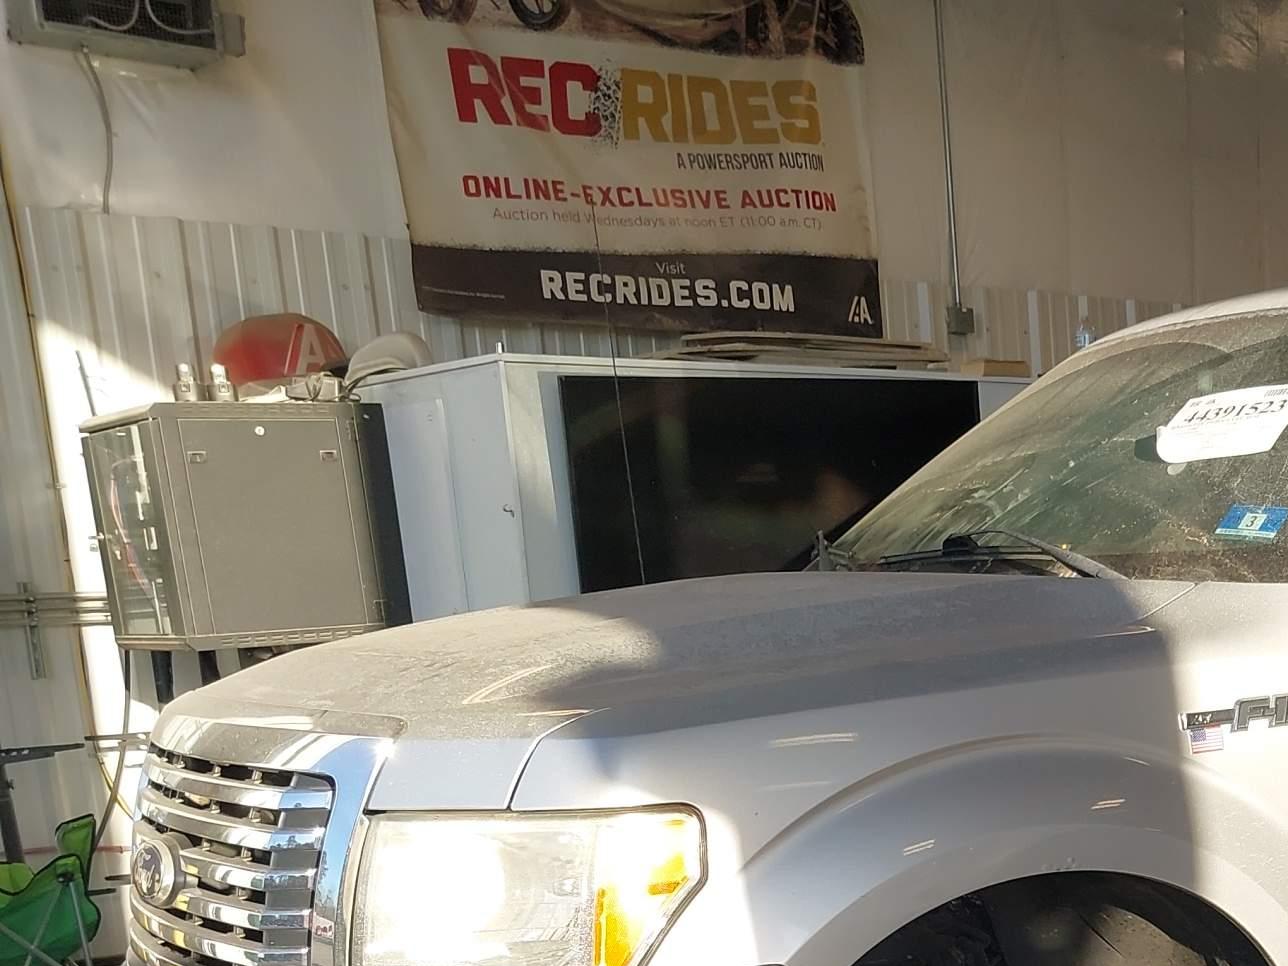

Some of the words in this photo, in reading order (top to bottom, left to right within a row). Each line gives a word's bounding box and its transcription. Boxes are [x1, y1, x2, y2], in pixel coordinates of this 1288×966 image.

[677, 153, 687, 171] A
[689, 152, 775, 171] POWERSPORT
[779, 152, 824, 172] AUCTION
[462, 174, 731, 210] ONLINE-EXCLUSIVE
[740, 188, 837, 212] AUCTION
[493, 207, 549, 222] Auction
[553, 209, 581, 224] held
[583, 212, 666, 228] Wednesdays
[668, 216, 681, 228] at
[685, 218, 717, 229] noon
[719, 216, 735, 228] ET
[803, 217, 822, 231] CT)
[656, 262, 686, 275] Visit
[540, 269, 795, 313] RECRIDES.COM
[1184, 399, 1288, 423] 44391523
[1246, 515, 1257, 528] 3
